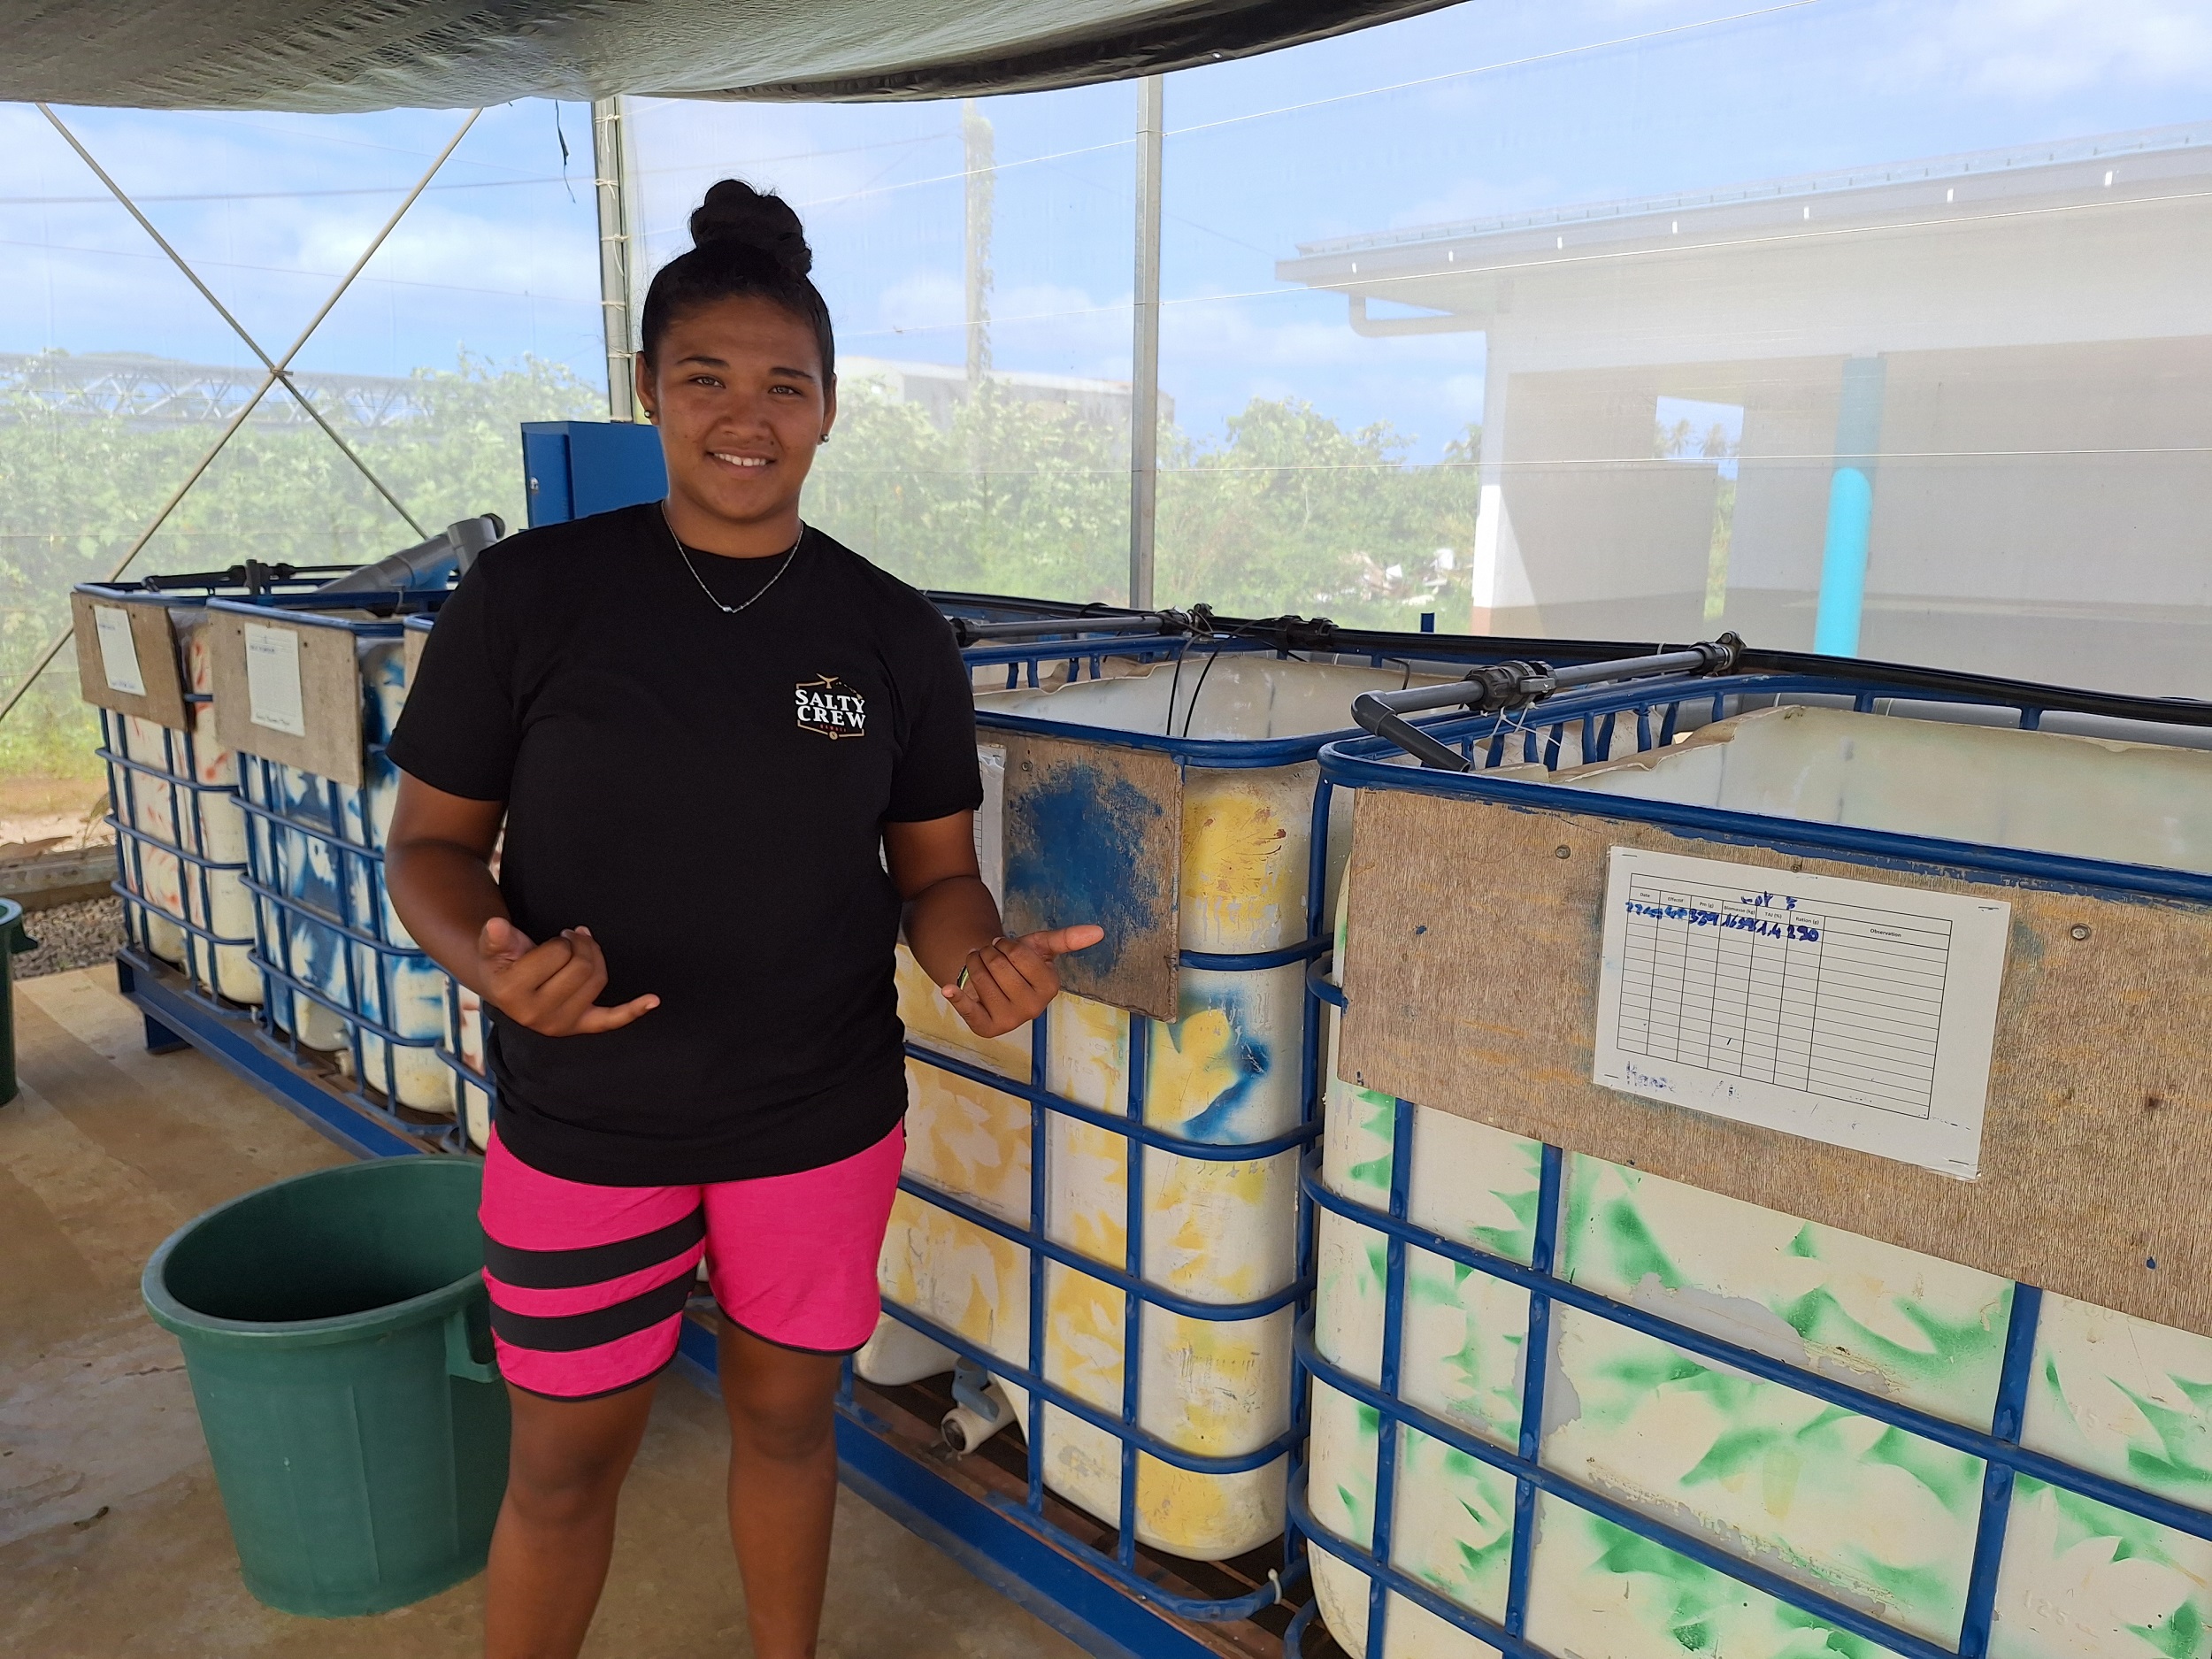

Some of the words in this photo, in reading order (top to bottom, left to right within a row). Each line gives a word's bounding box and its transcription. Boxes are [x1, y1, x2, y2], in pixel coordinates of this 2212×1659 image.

[795, 689, 865, 713] SALTY
[796, 705, 866, 729] CREW
[1870, 928, 1901, 937] Observation
